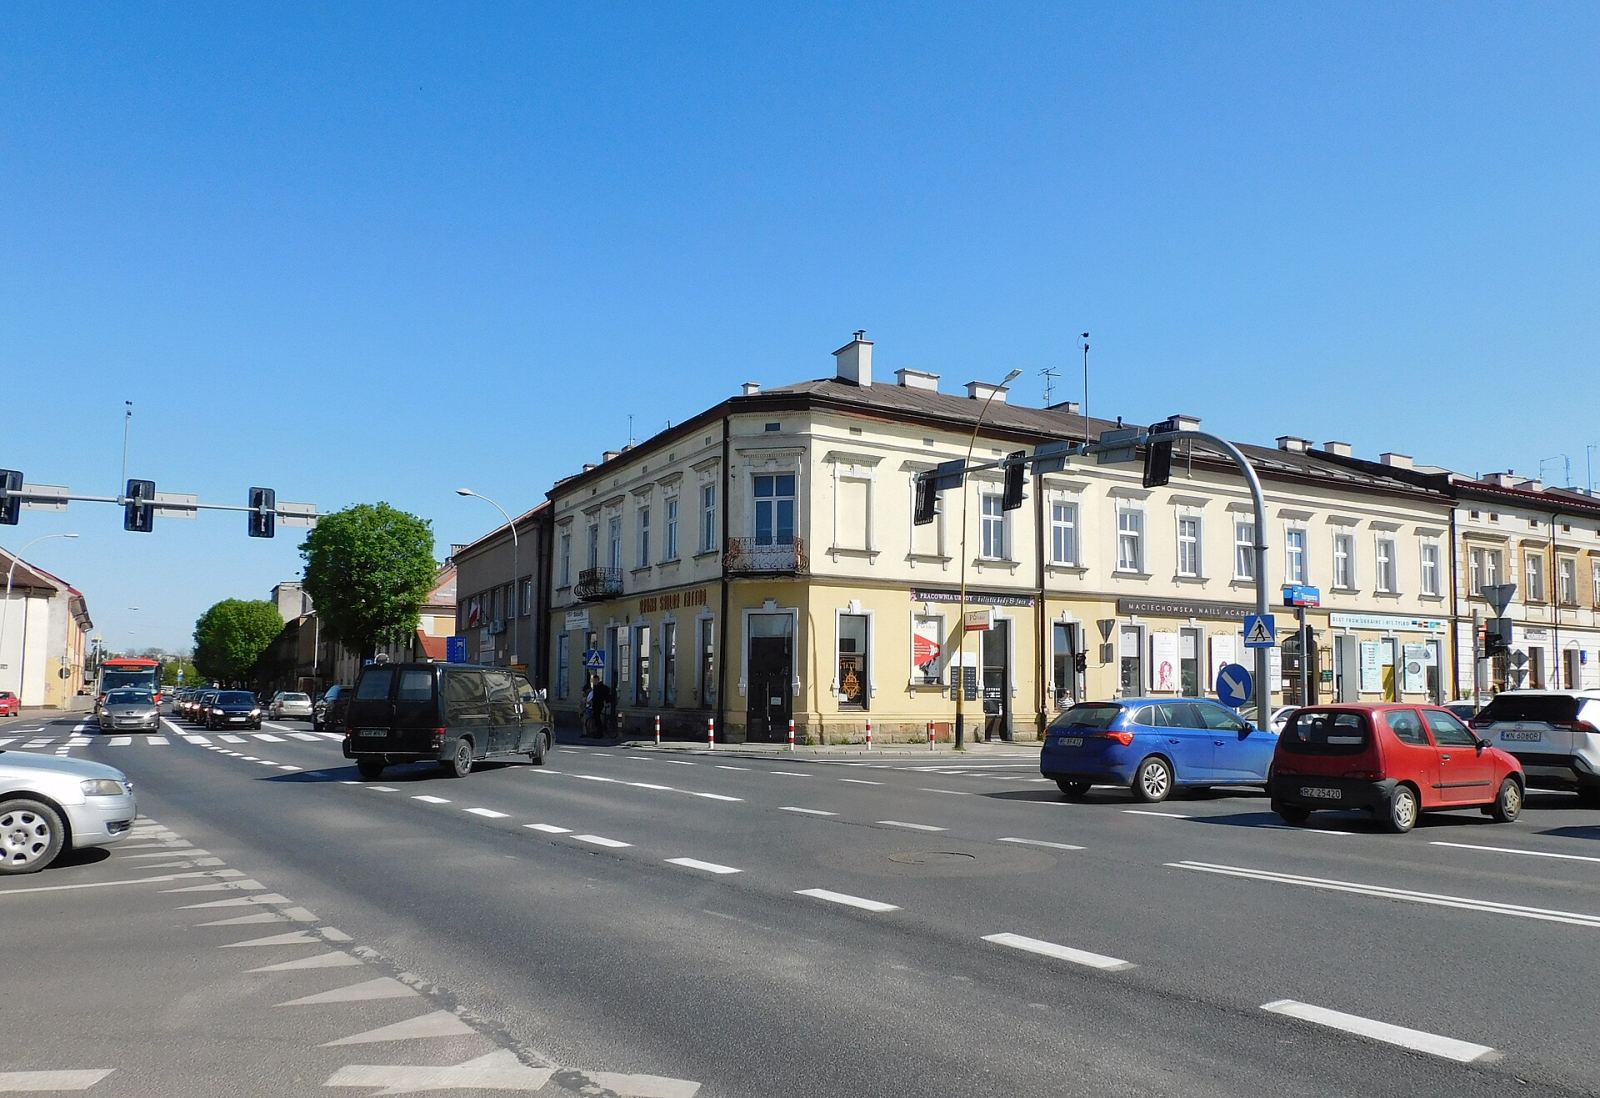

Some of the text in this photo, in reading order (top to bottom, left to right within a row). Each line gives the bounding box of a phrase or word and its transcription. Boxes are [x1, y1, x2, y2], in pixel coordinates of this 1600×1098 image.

[1128, 603, 1255, 617] MACIECHOWSKA NAILS ACADEM
